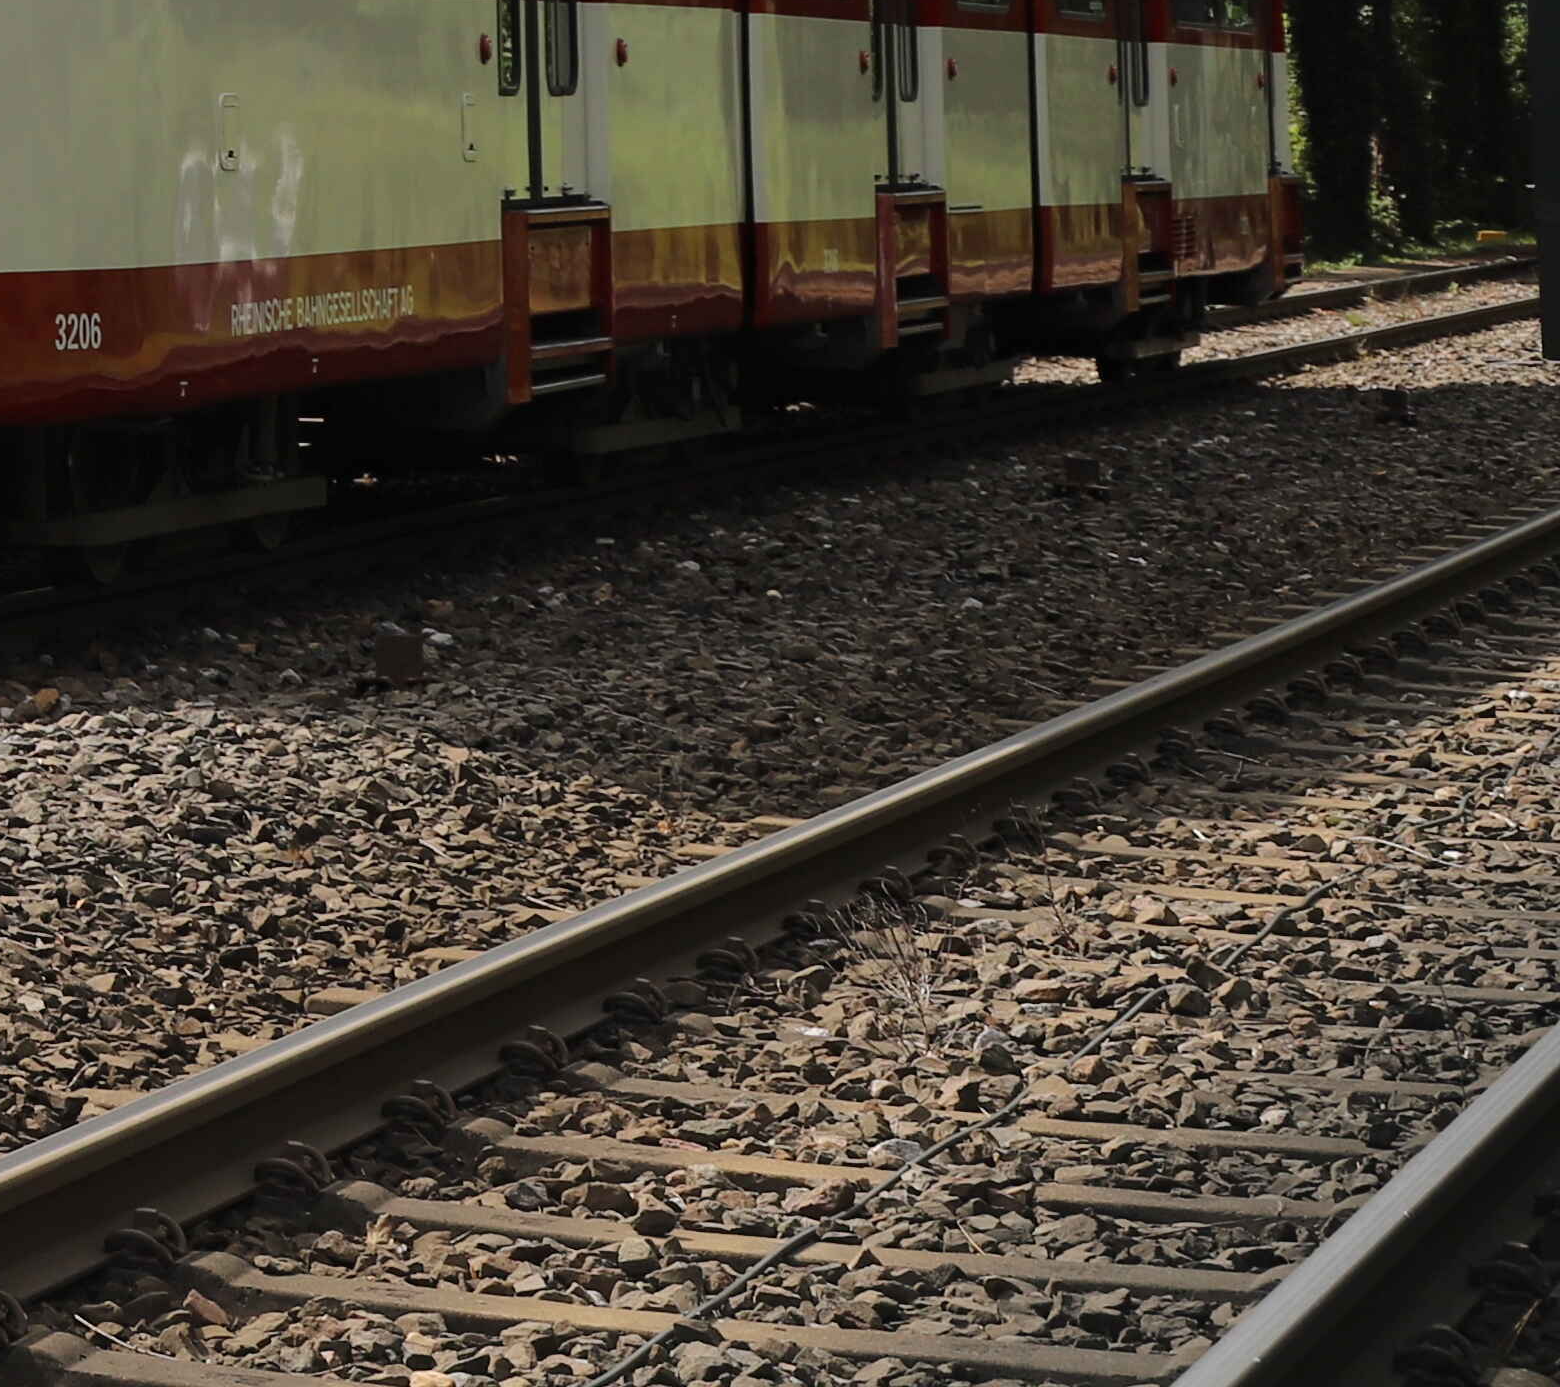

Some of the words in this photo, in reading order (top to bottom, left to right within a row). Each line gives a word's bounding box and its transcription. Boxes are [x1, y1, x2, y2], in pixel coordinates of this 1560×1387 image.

[55, 313, 102, 350] 3206
[231, 298, 293, 338] RHEINISCHE
[296, 288, 399, 328] BAHNGESELLSCHAFT
[400, 284, 414, 316] AG
